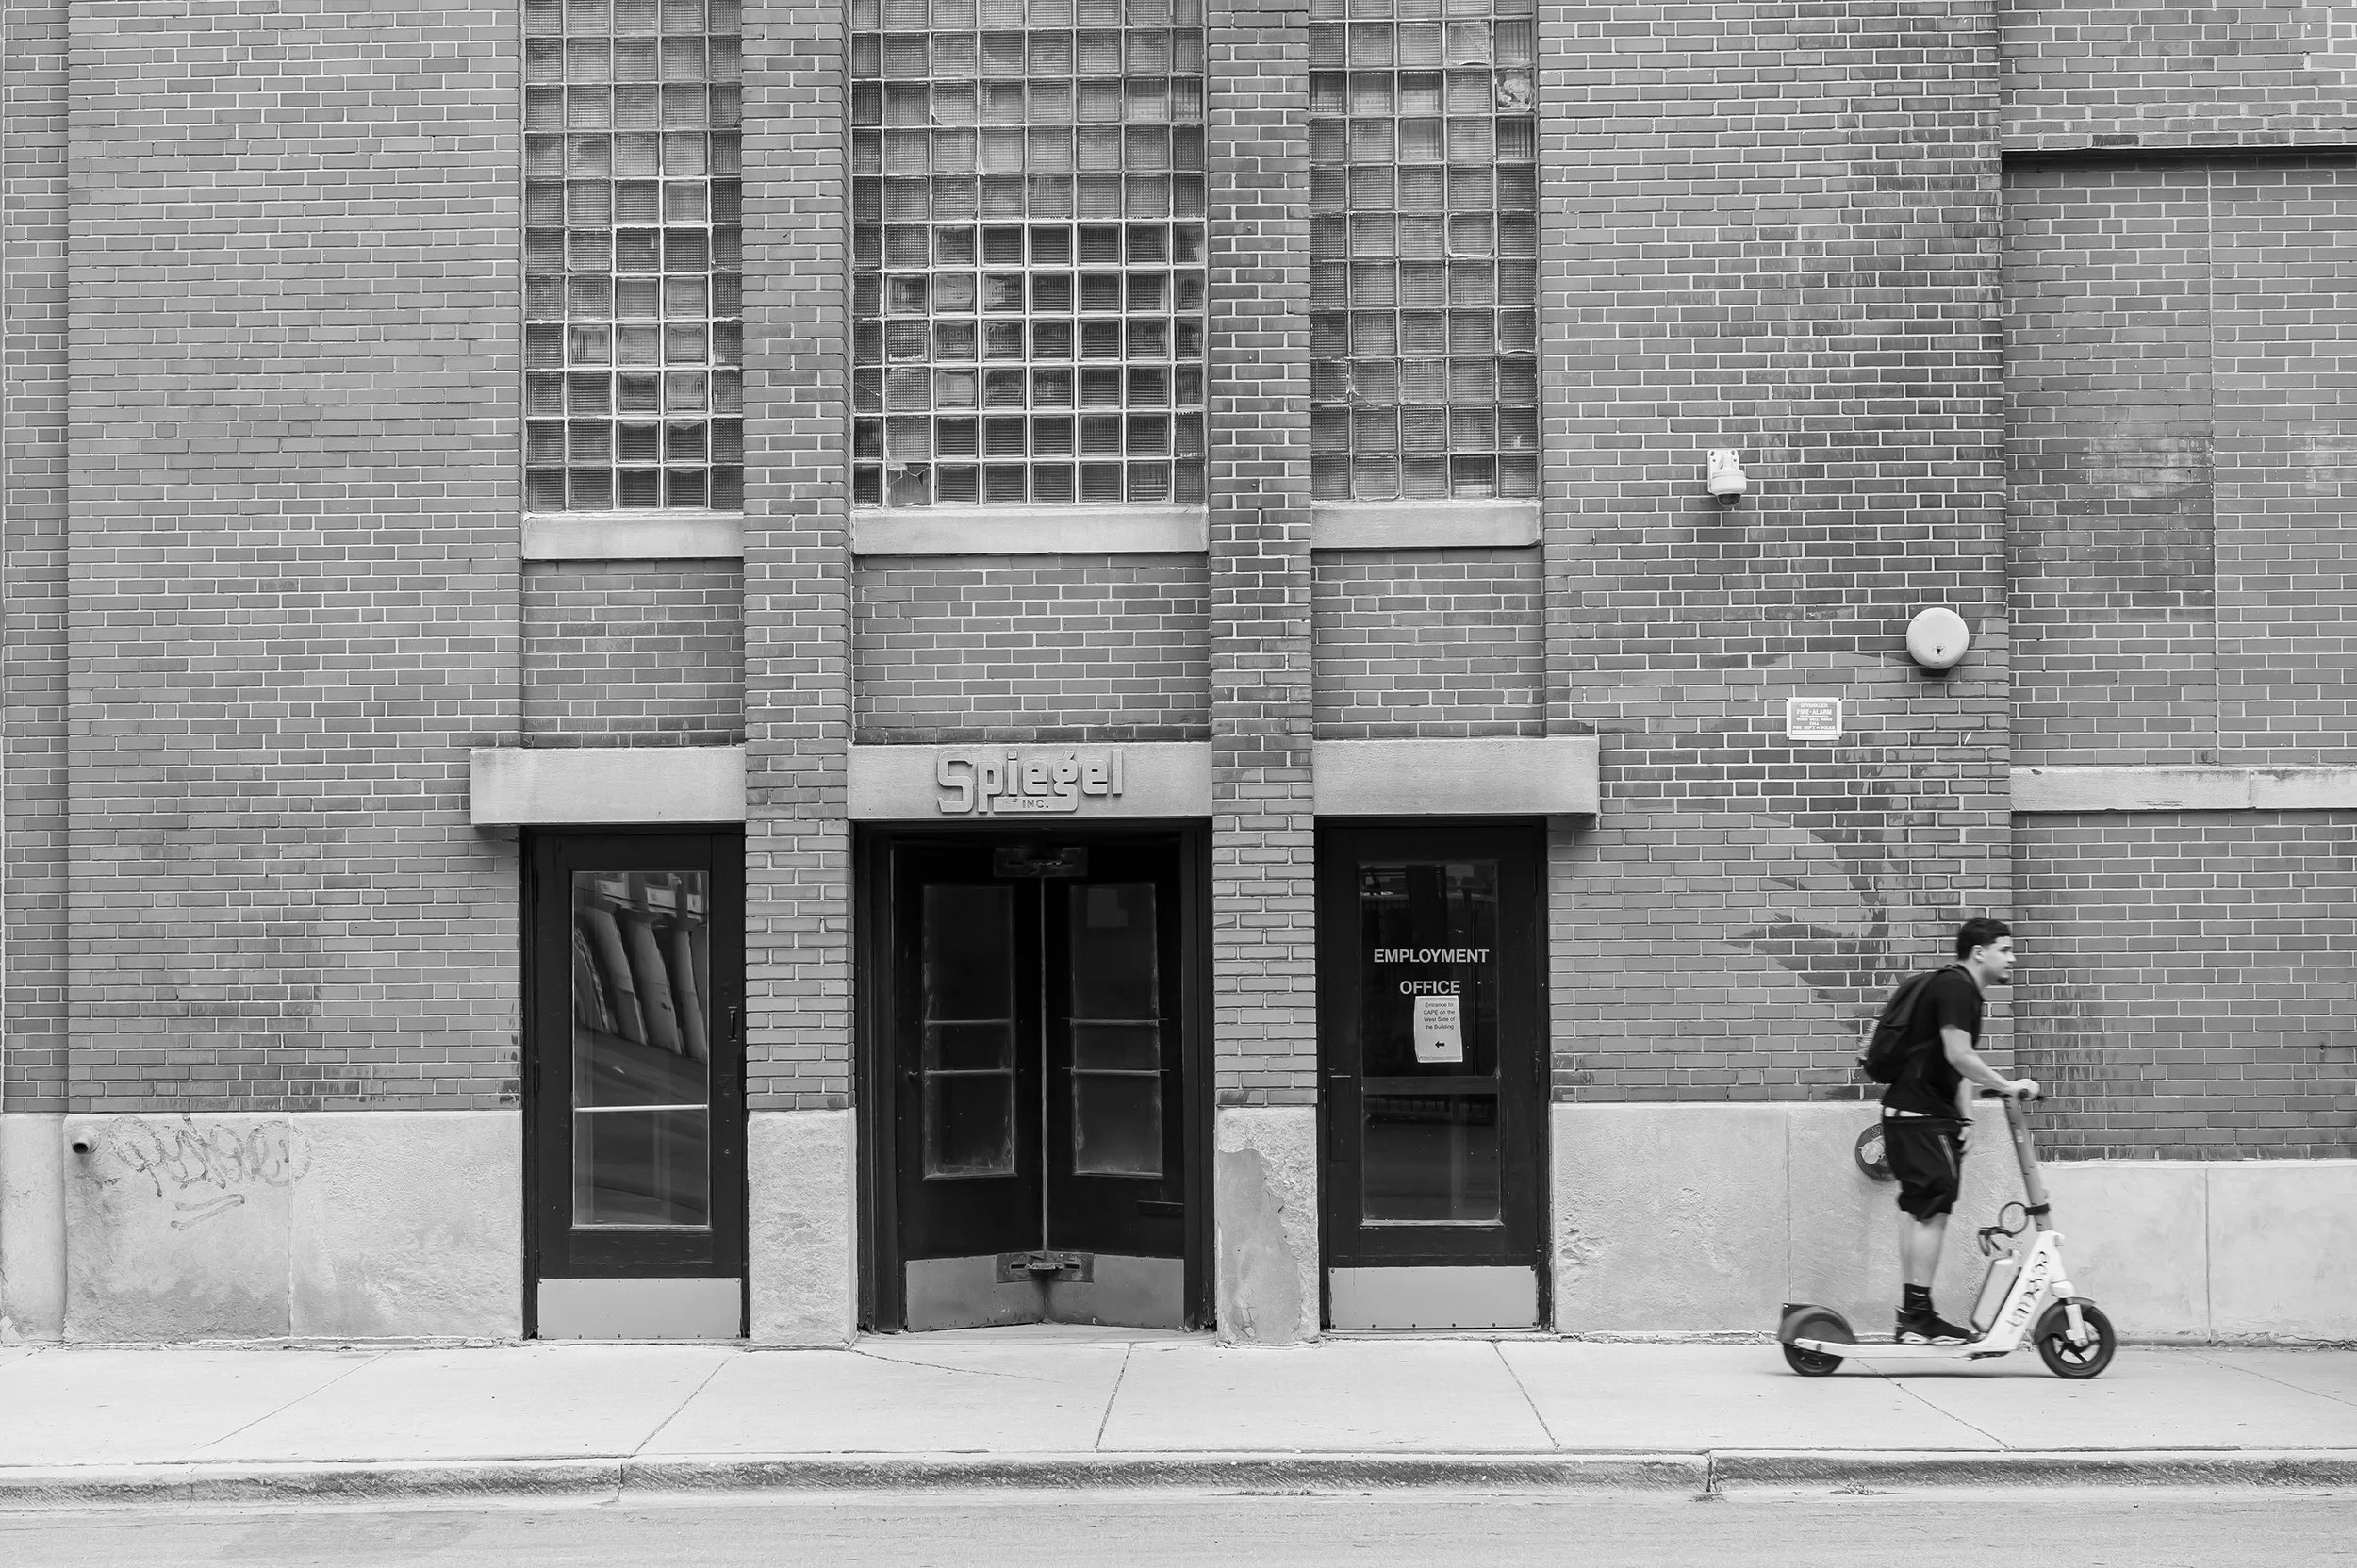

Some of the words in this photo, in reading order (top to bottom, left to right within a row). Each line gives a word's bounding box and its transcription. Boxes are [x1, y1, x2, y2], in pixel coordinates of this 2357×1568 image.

[937, 749, 1123, 815] Spiegel
[1021, 799, 1049, 809] INC.
[1374, 949, 1490, 964] EMPLOYMENT
[1399, 980, 1461, 995] OFFICE
